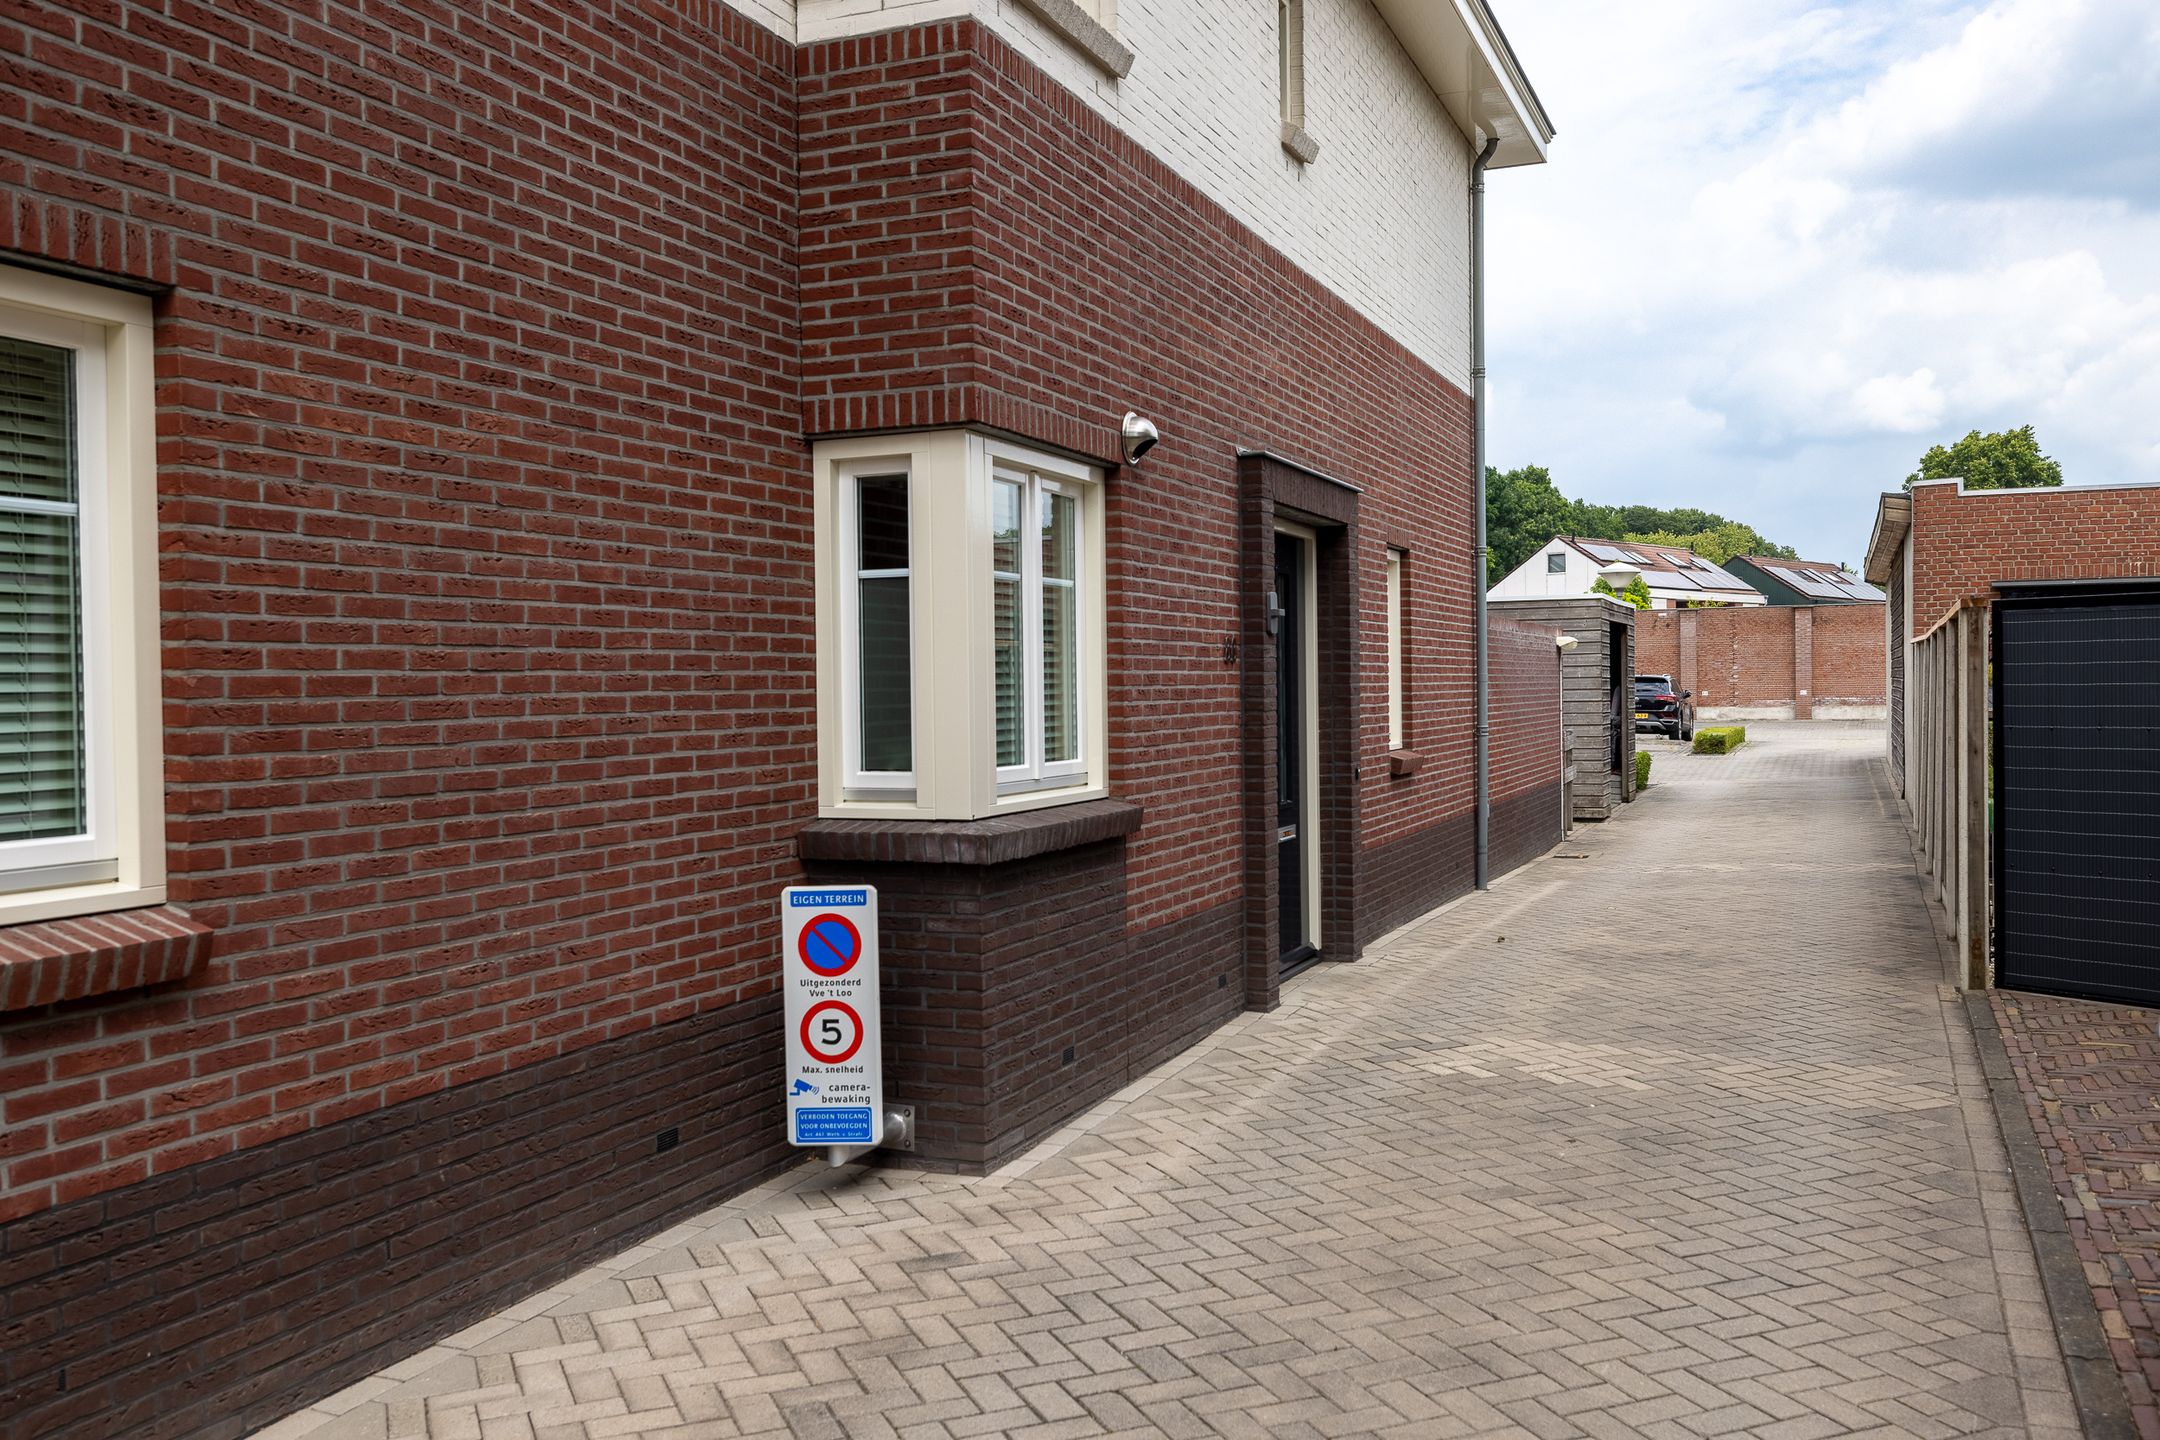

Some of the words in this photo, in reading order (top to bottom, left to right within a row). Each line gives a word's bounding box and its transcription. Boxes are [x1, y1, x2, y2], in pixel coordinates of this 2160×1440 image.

[793, 896, 822, 904] EIGEN
[824, 894, 864, 904] TERREIN
[800, 978, 861, 988] Uitgezonderd
[821, 1018, 842, 1045] 5
[825, 1065, 864, 1074] snelheid
[828, 1084, 871, 1092] camera-
[822, 1094, 871, 1104] bewaking
